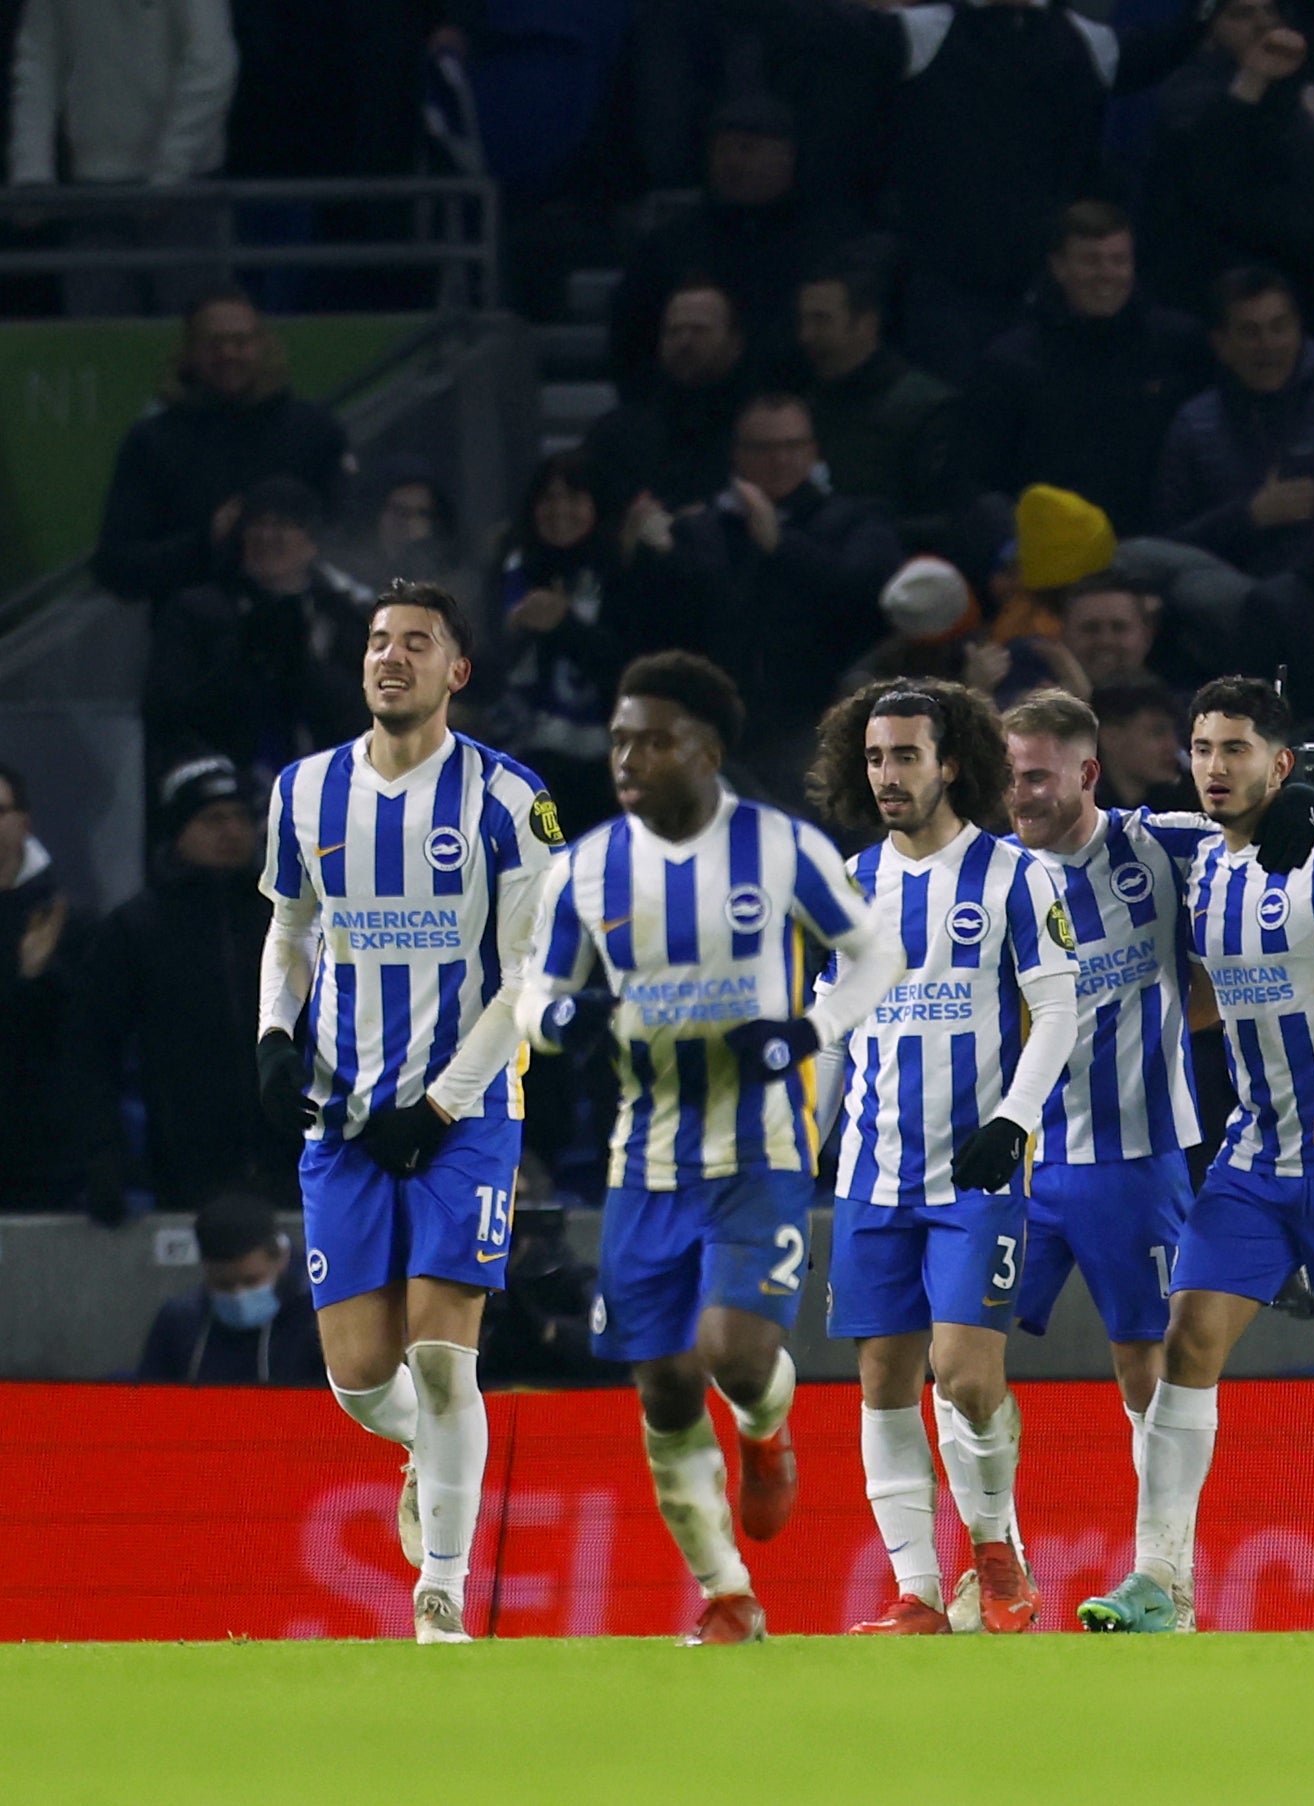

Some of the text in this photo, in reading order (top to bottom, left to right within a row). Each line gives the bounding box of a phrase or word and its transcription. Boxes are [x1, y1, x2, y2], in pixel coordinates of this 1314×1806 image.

[332, 909, 458, 929] AMERICAN
[349, 930, 461, 950] EXPRESS
[1078, 936, 1156, 978] ERICAN
[624, 975, 757, 1003] AMERICAN
[1211, 964, 1289, 987] MERICAN
[875, 1002, 973, 1024] EXPRESS
[475, 1185, 508, 1246] 15
[769, 1223, 804, 1291] 2
[992, 1234, 1017, 1290] 3
[1149, 1244, 1179, 1300] 1
